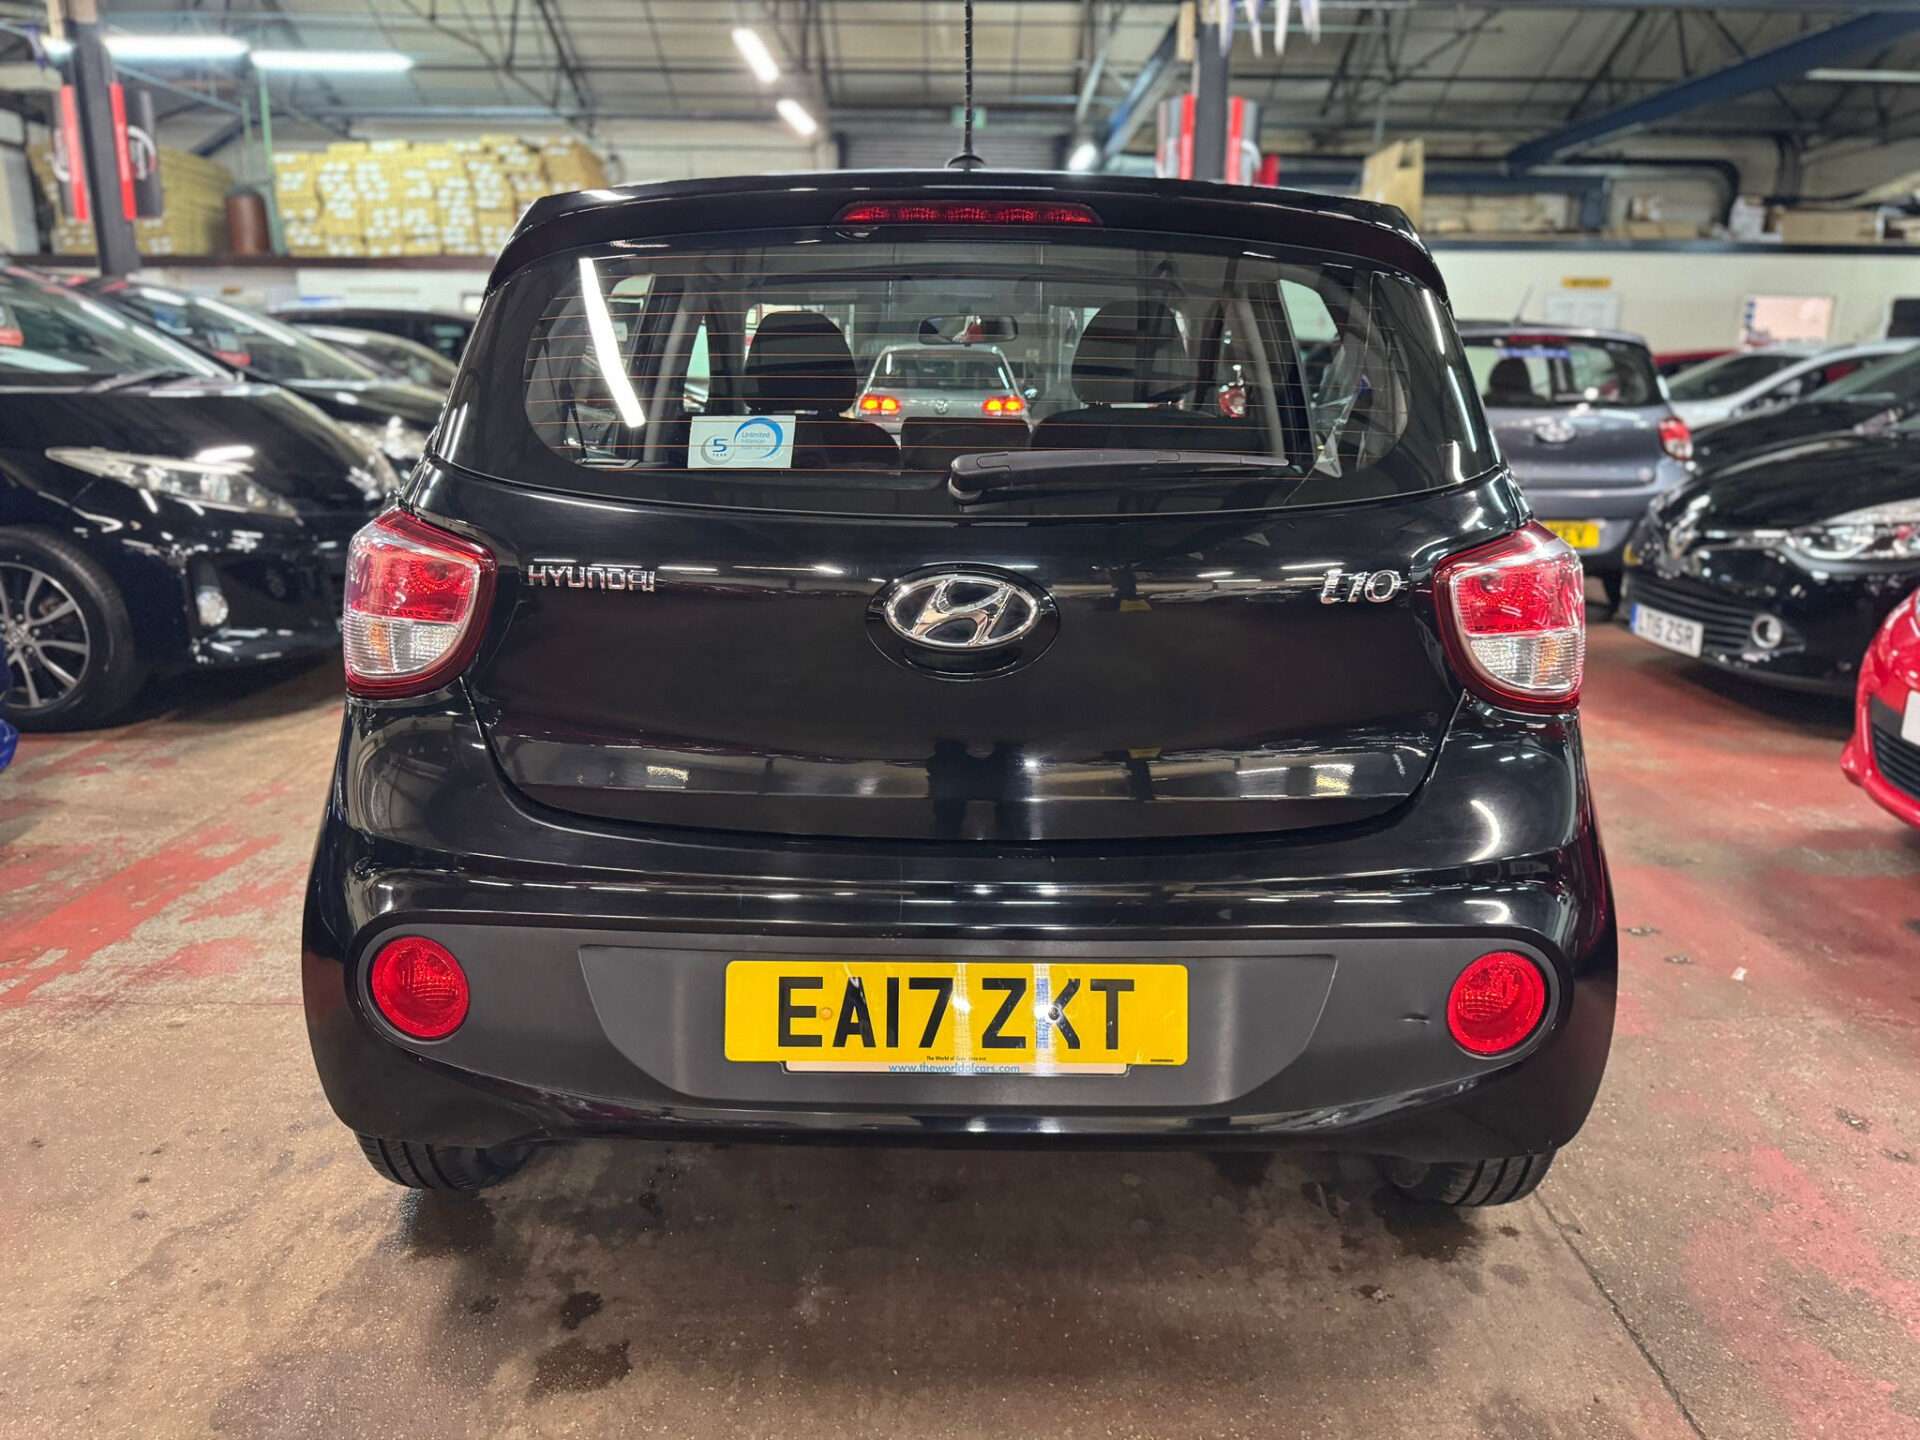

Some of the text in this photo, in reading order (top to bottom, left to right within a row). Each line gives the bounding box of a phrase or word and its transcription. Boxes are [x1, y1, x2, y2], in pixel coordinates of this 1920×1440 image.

[712, 438, 728, 452] 5
[528, 564, 656, 592] HYUNDAI
[1320, 568, 1401, 605] i10
[779, 977, 1134, 1049] EA17 ZKT
